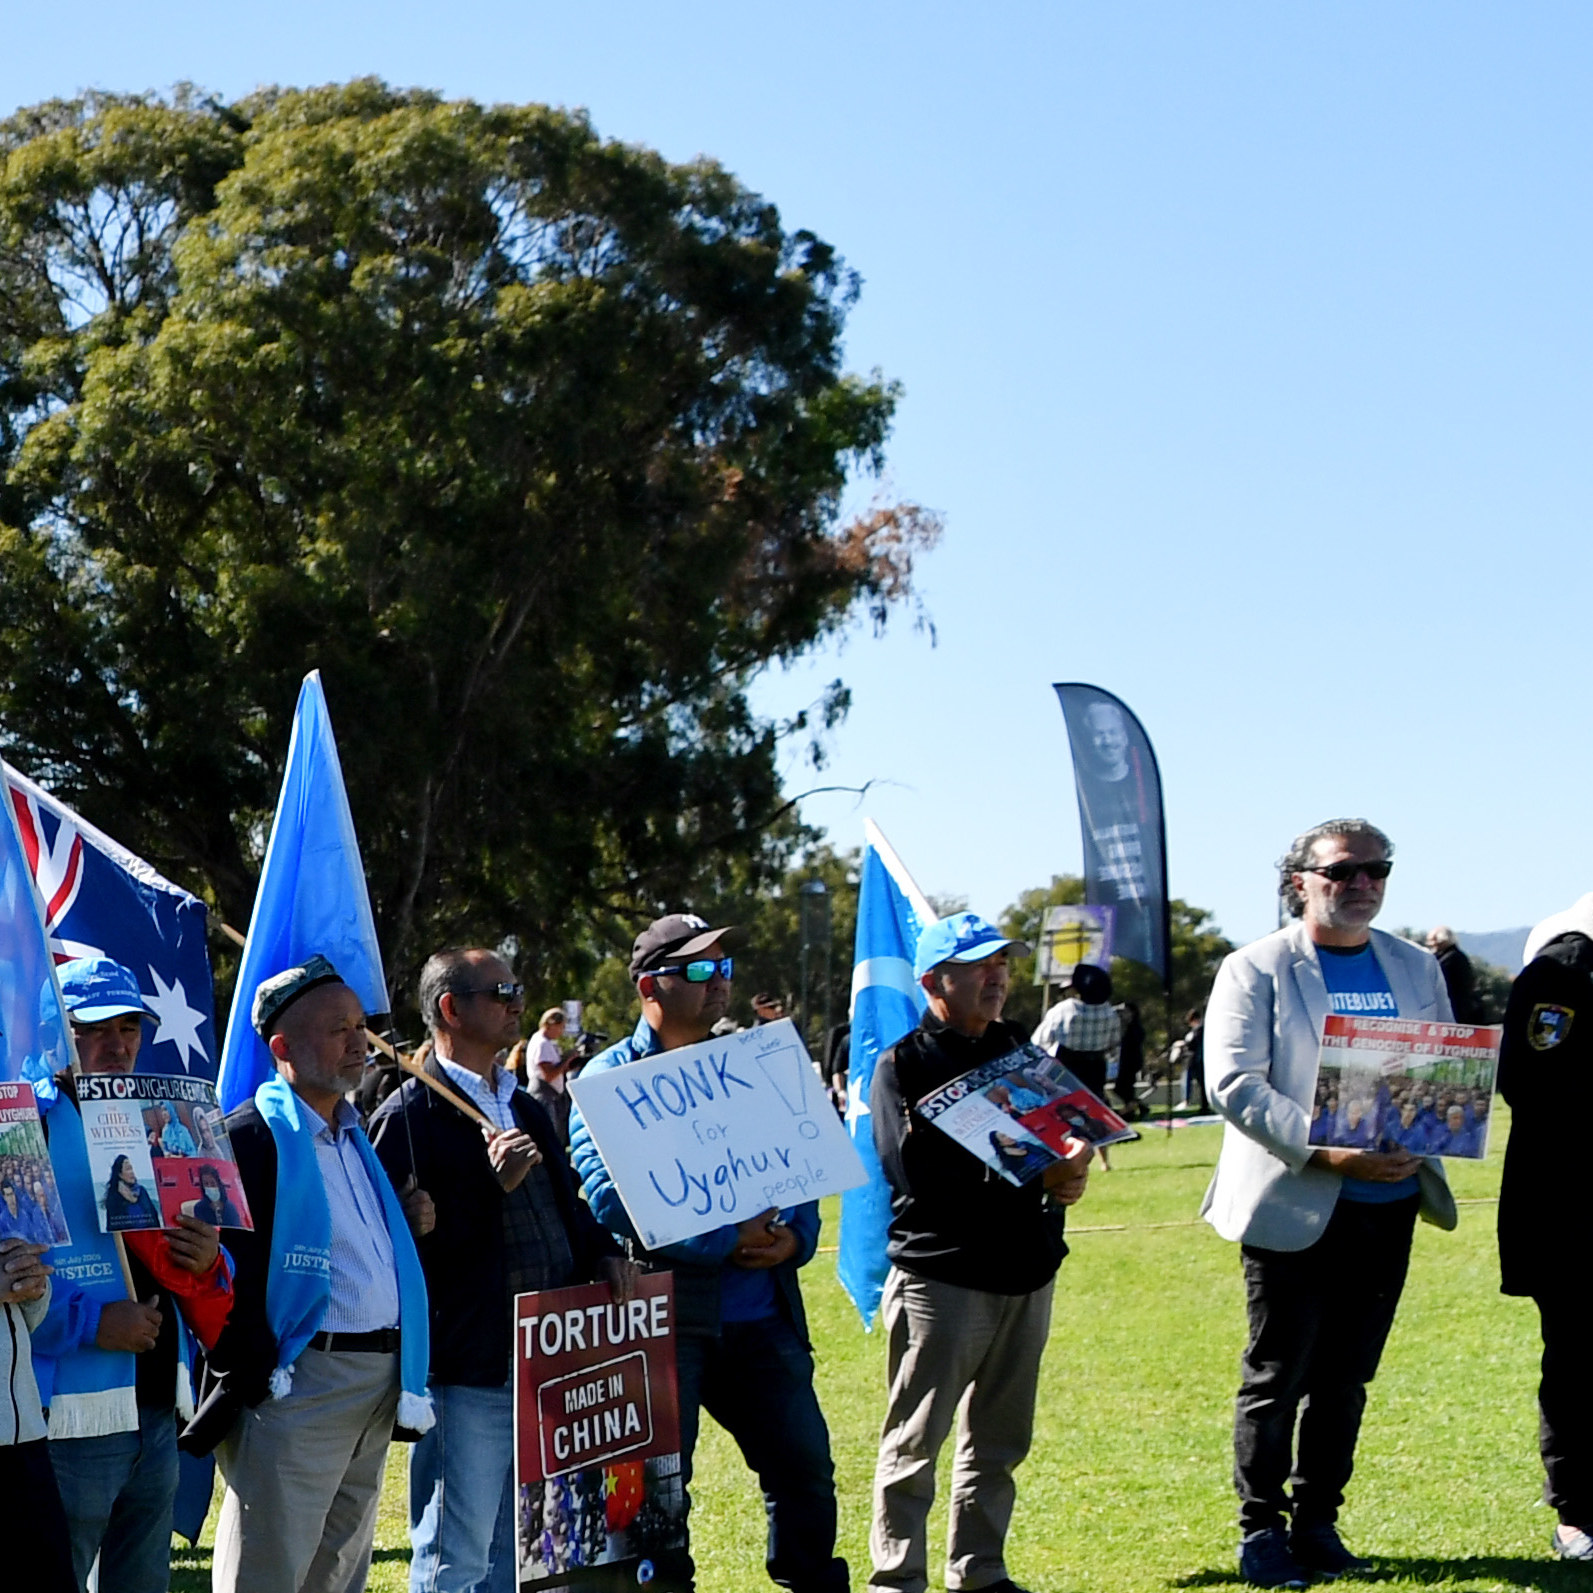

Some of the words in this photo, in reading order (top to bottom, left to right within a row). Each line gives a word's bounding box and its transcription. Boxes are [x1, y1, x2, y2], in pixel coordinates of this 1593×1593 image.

[1323, 1035, 1348, 1048] THE
[1352, 1037, 1412, 1052] GENOCIDE
[1414, 1043, 1430, 1054] OF
[1434, 1045, 1496, 1059] UYGHURS
[1354, 1019, 1420, 1035] RECOGNISE
[1428, 1025, 1437, 1037] &
[1441, 1027, 1474, 1039] STOP
[615, 1051, 754, 1130] HONK
[90, 1125, 142, 1140] WITNESS
[97, 1112, 131, 1126] CHIEF
[692, 1119, 729, 1146] for
[648, 1147, 791, 1216] Uyghur
[760, 1158, 829, 1202] people
[518, 1294, 671, 1360] TORTURE
[564, 1379, 606, 1415] MADE
[607, 1372, 625, 1399] IN
[553, 1402, 642, 1460] CHINA
